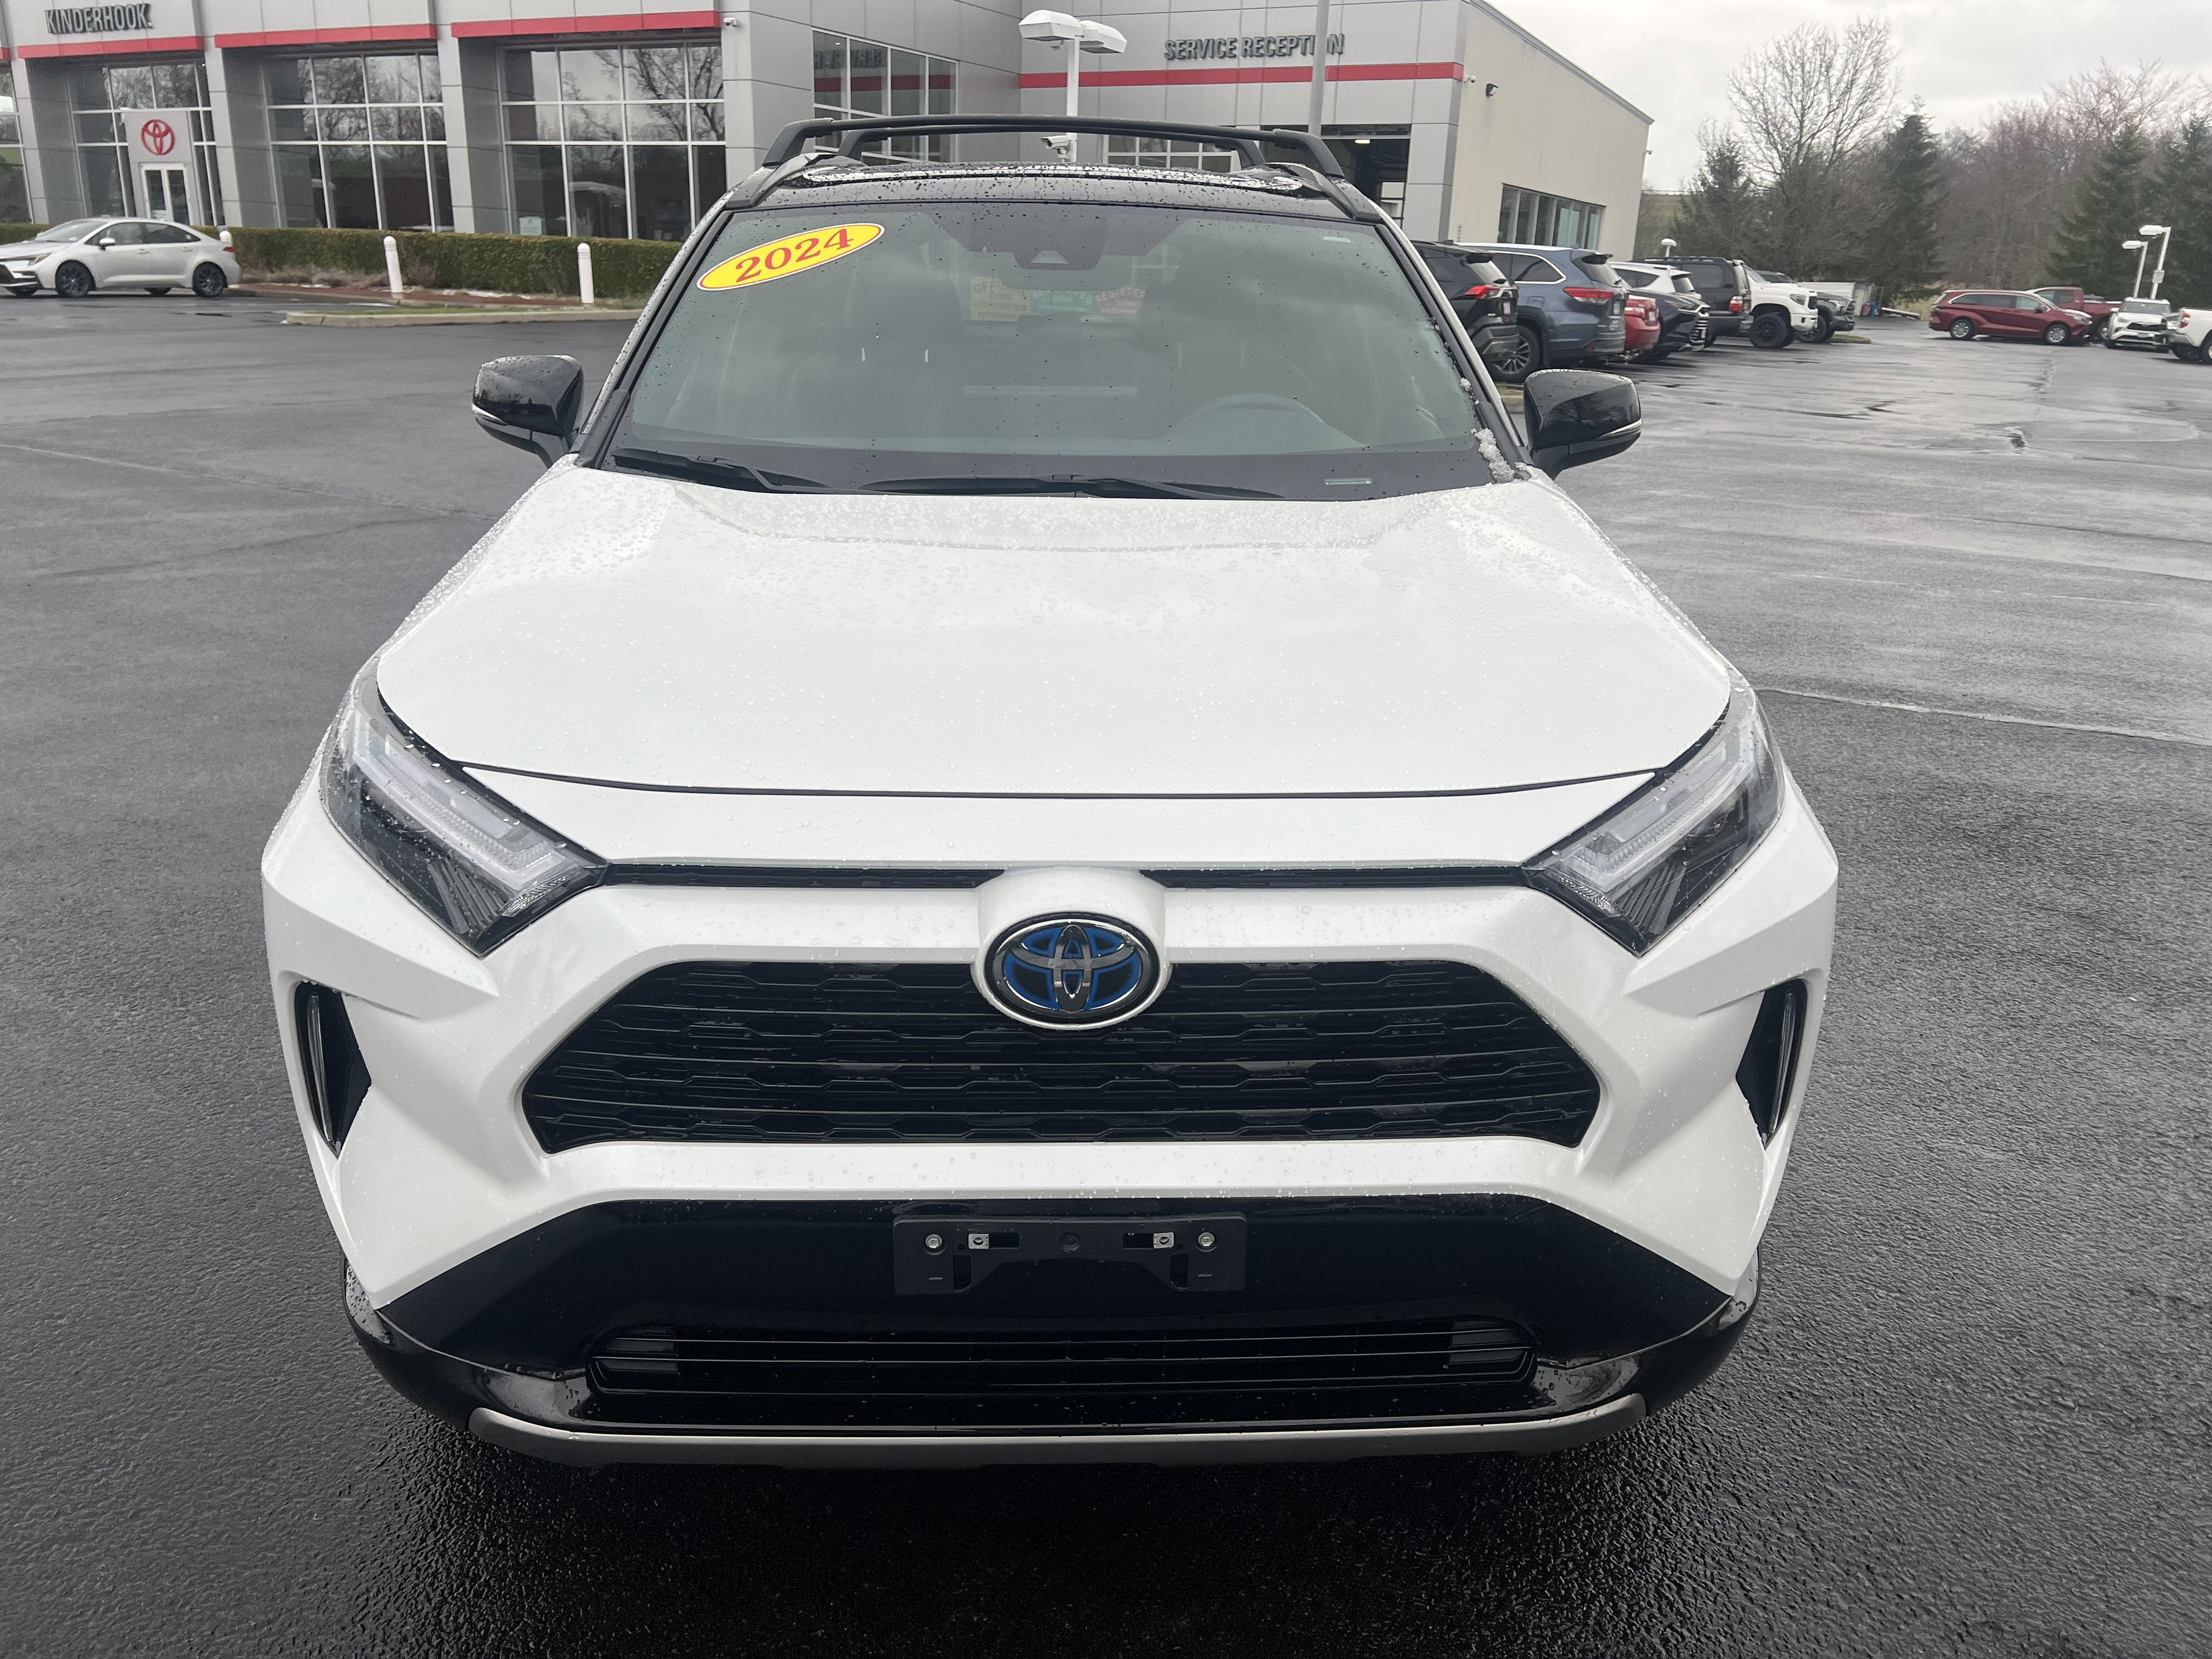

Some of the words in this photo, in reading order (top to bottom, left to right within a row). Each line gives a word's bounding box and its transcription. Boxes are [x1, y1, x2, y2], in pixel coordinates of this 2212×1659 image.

[45, 3, 150, 34] KINDERHOOK
[1165, 38, 1238, 60] SERVICE
[1242, 34, 1344, 57] RECEPTIN
[736, 228, 854, 283] 2024
